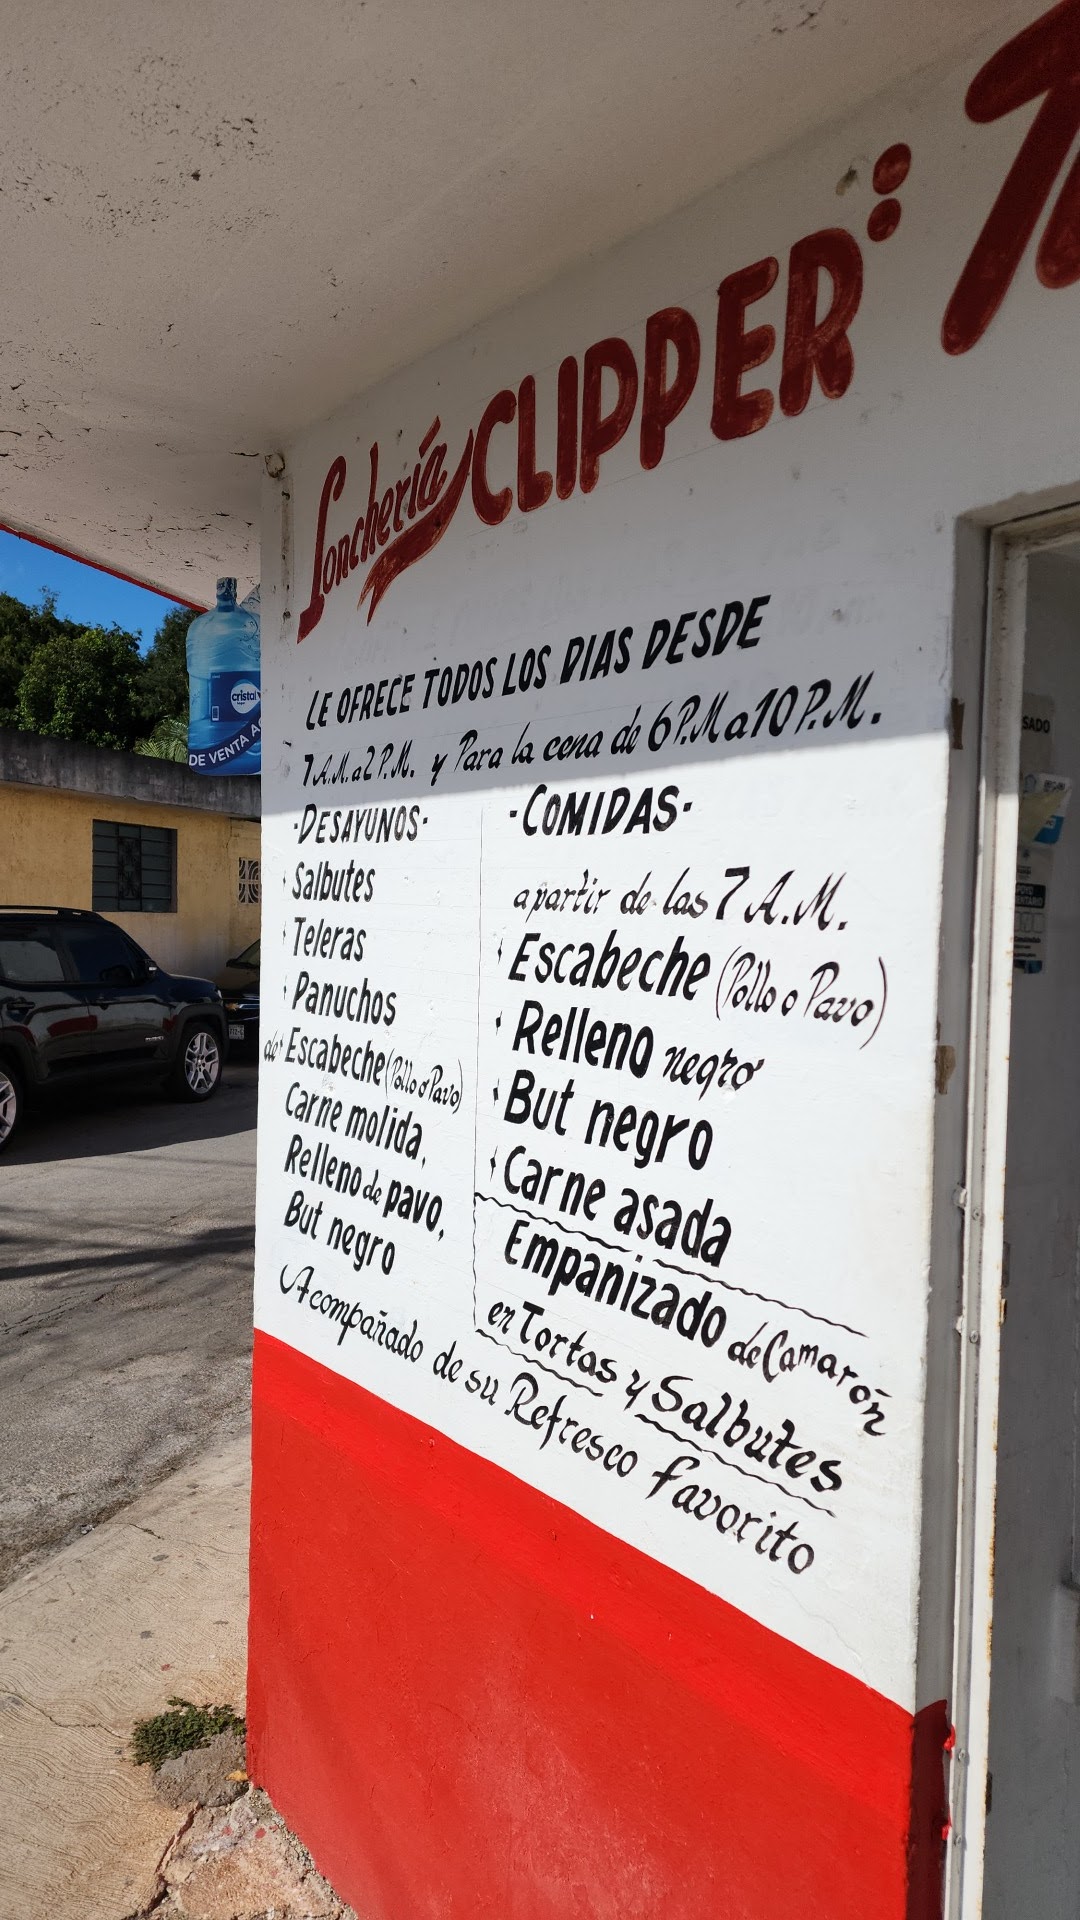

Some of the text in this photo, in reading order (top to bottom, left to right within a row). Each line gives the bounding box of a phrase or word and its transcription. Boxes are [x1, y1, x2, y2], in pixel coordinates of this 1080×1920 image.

[232, 689, 257, 701] cristal
[306, 594, 772, 731] LE OFRECE TODOS LOS DIAS DESDE
[189, 754, 206, 766] DE
[208, 735, 249, 764] VENTA
[430, 753, 448, 786] y
[454, 729, 503, 772] Para
[510, 722, 535, 765] la
[543, 728, 603, 761] cena
[610, 705, 641, 754] de
[292, 859, 375, 902] Salbutes
[620, 871, 652, 915] de
[662, 866, 709, 919] las
[715, 866, 750, 920] 7
[293, 917, 366, 962] Teleras
[507, 929, 711, 1001] Escabeche
[781, 989, 798, 1017] o
[292, 971, 396, 1026] Panuchos
[284, 1027, 385, 1086] Escabeche
[512, 1000, 765, 1101] Relleno negro
[285, 1082, 426, 1168] Carne molida,
[503, 1069, 714, 1170] But negro
[284, 1134, 444, 1241] Relleno de pavo,
[503, 1145, 732, 1268] Carne asada
[283, 1190, 395, 1275] But negro
[503, 1219, 893, 1437] Empanizado de Camarón
[279, 1264, 815, 1575] Acompañado de su Refresco favorito
[487, 1301, 844, 1493] en Tortas y Salbutes
